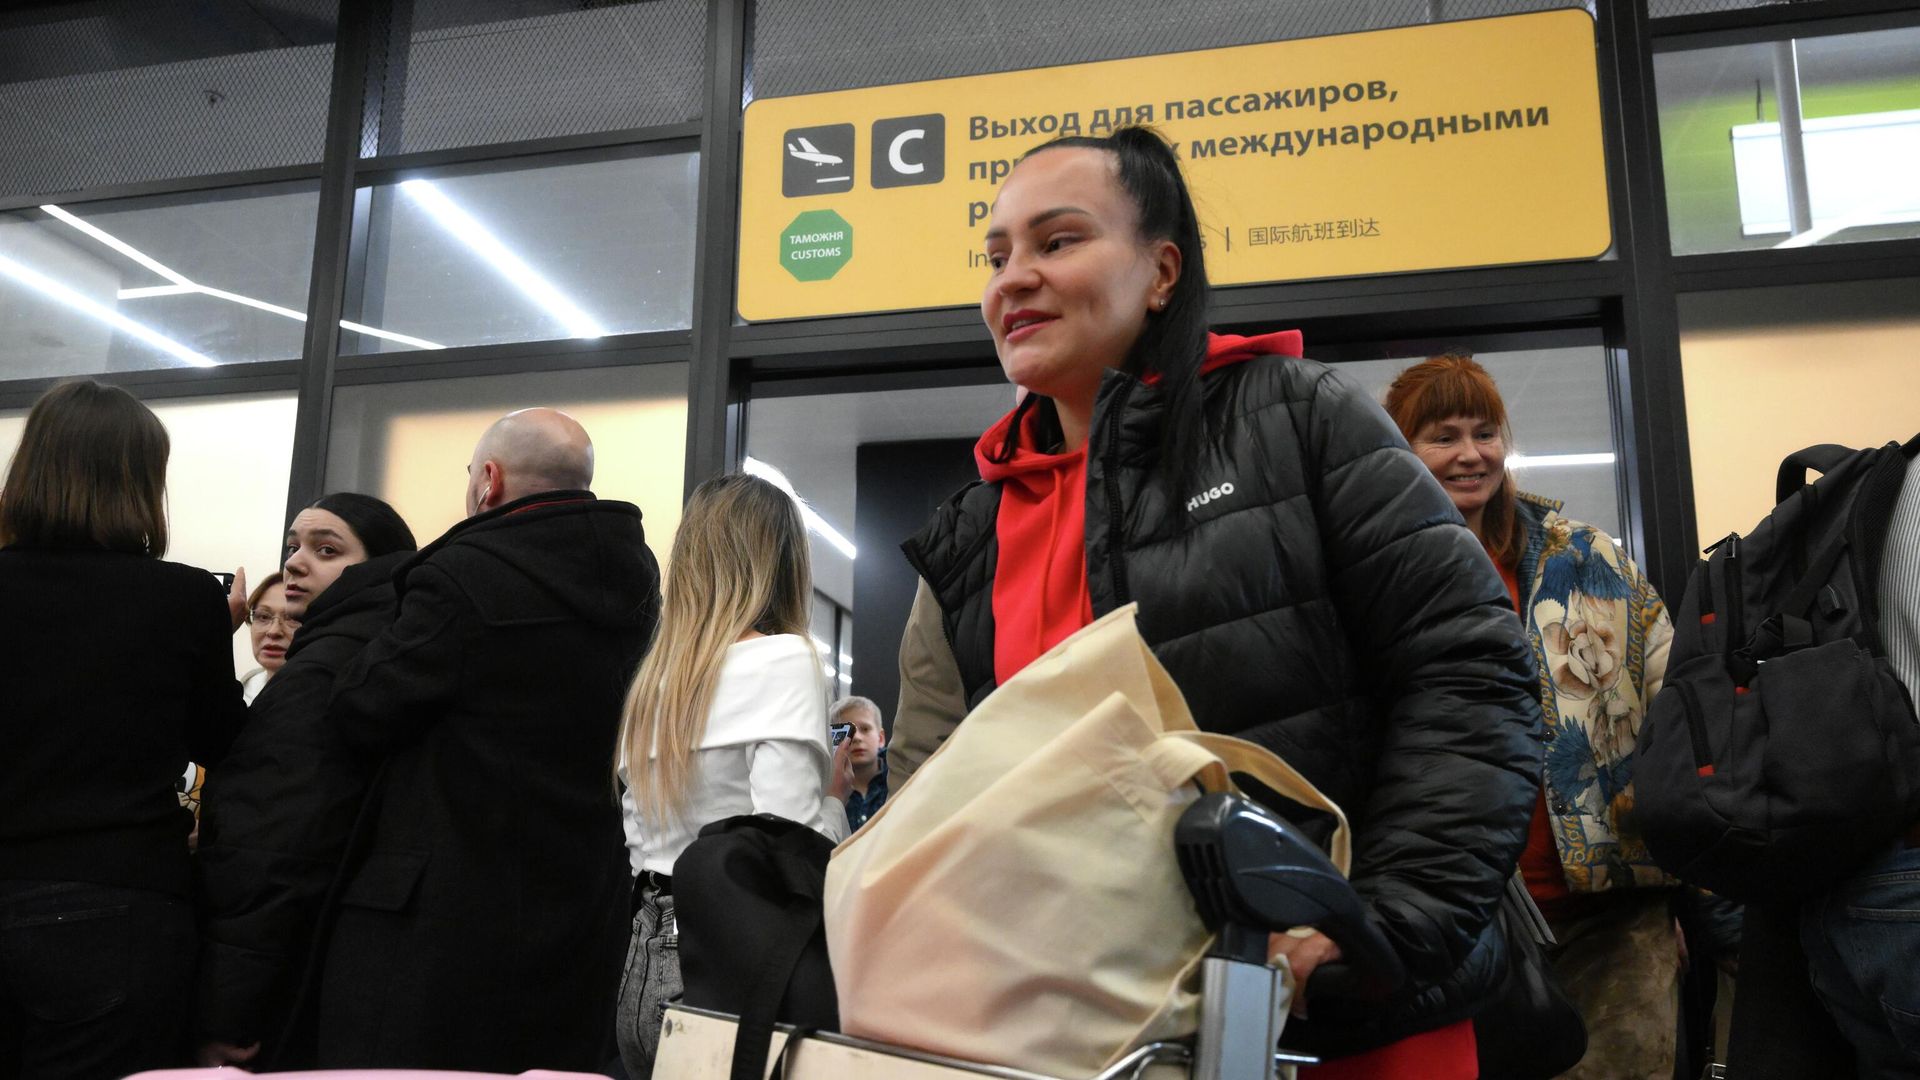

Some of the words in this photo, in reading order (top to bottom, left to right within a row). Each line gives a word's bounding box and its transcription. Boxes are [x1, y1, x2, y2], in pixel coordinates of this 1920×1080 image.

[969, 115, 1081, 141] Выход
[1089, 104, 1154, 134] для
[1165, 80, 1398, 121] пассажиров,
[1191, 106, 1549, 159] международными
[790, 231, 844, 245] ТАМОЖНЯ
[1249, 217, 1381, 247] 国际航班到达
[791, 247, 842, 260] CUSTOMS
[1186, 482, 1235, 512] HUGO
